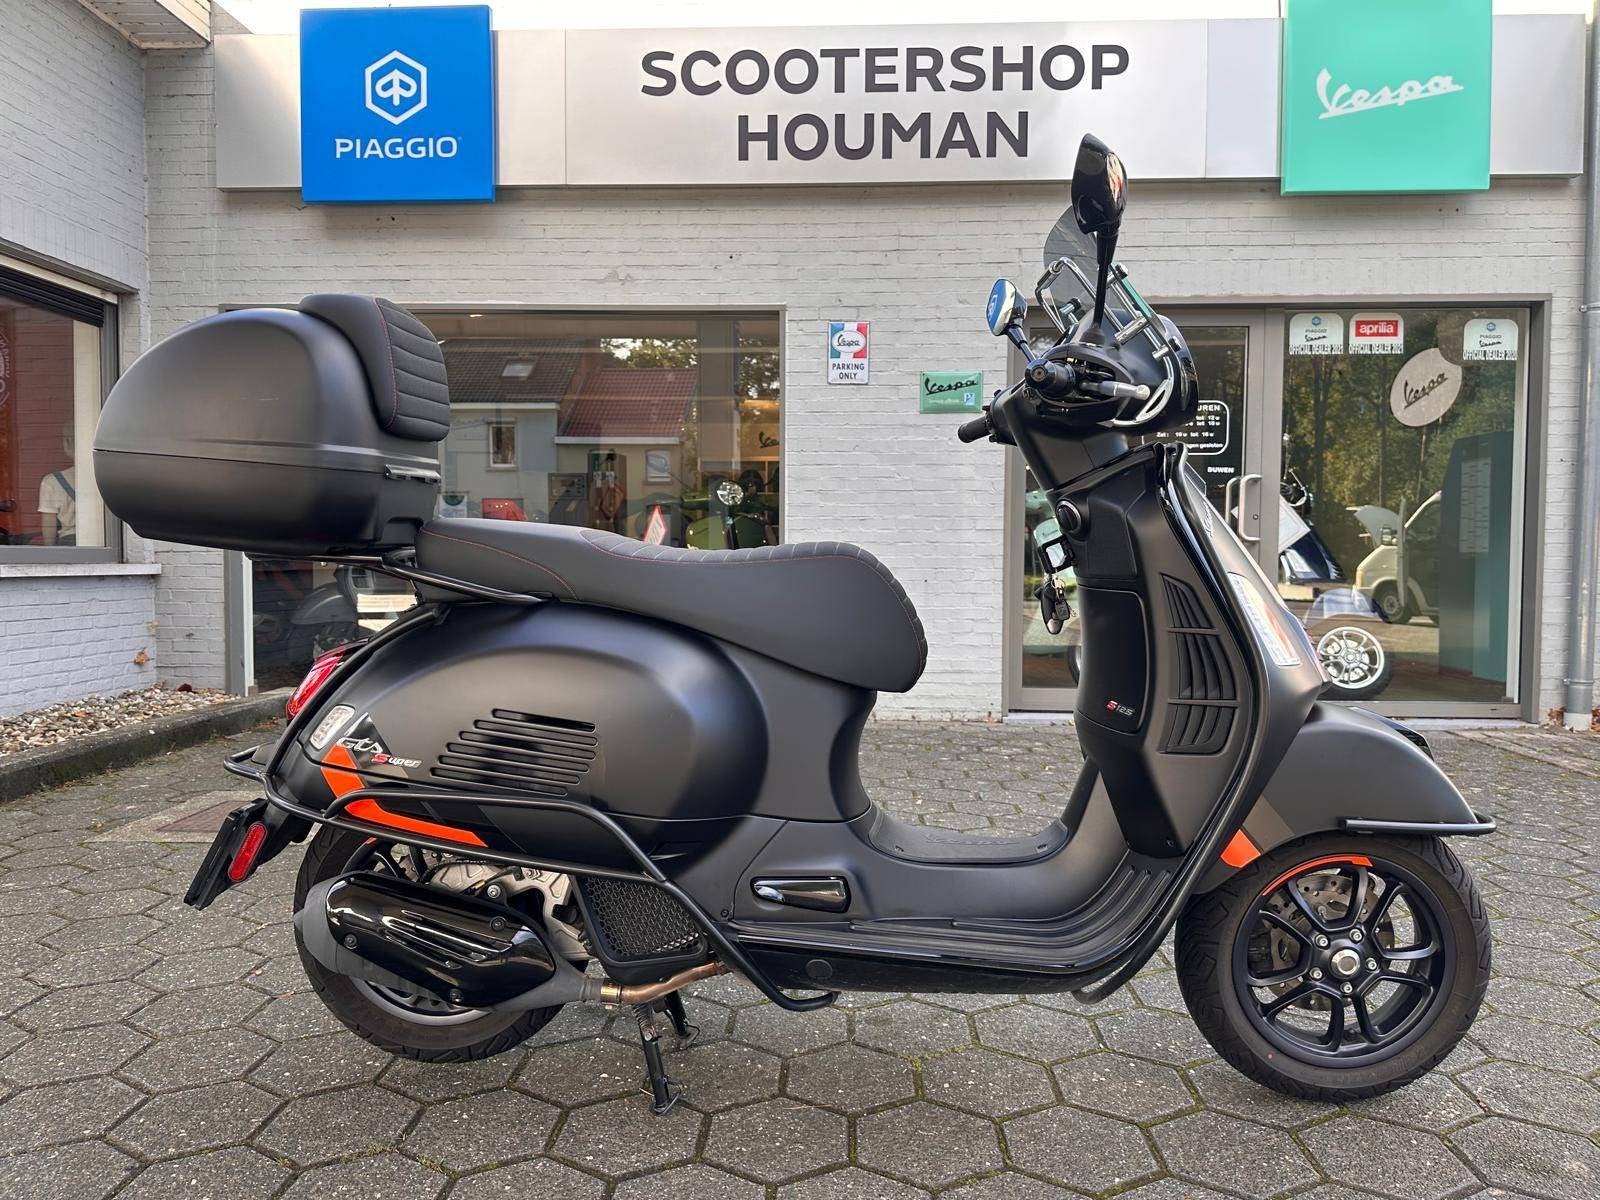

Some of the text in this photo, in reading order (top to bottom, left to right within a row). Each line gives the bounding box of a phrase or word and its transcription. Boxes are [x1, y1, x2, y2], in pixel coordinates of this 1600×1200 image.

[641, 44, 1130, 97] SCOOTERSHOP
[1316, 67, 1464, 120] Vespa
[738, 110, 1029, 162] HOUMAN
[335, 136, 458, 159] PIAGGIO
[1359, 321, 1395, 336] aprilia
[836, 333, 861, 347] Vespa
[831, 362, 865, 371] PARKING
[838, 371, 858, 380] ONLY
[925, 377, 978, 396] Vespa
[1404, 372, 1448, 409] Vespa
